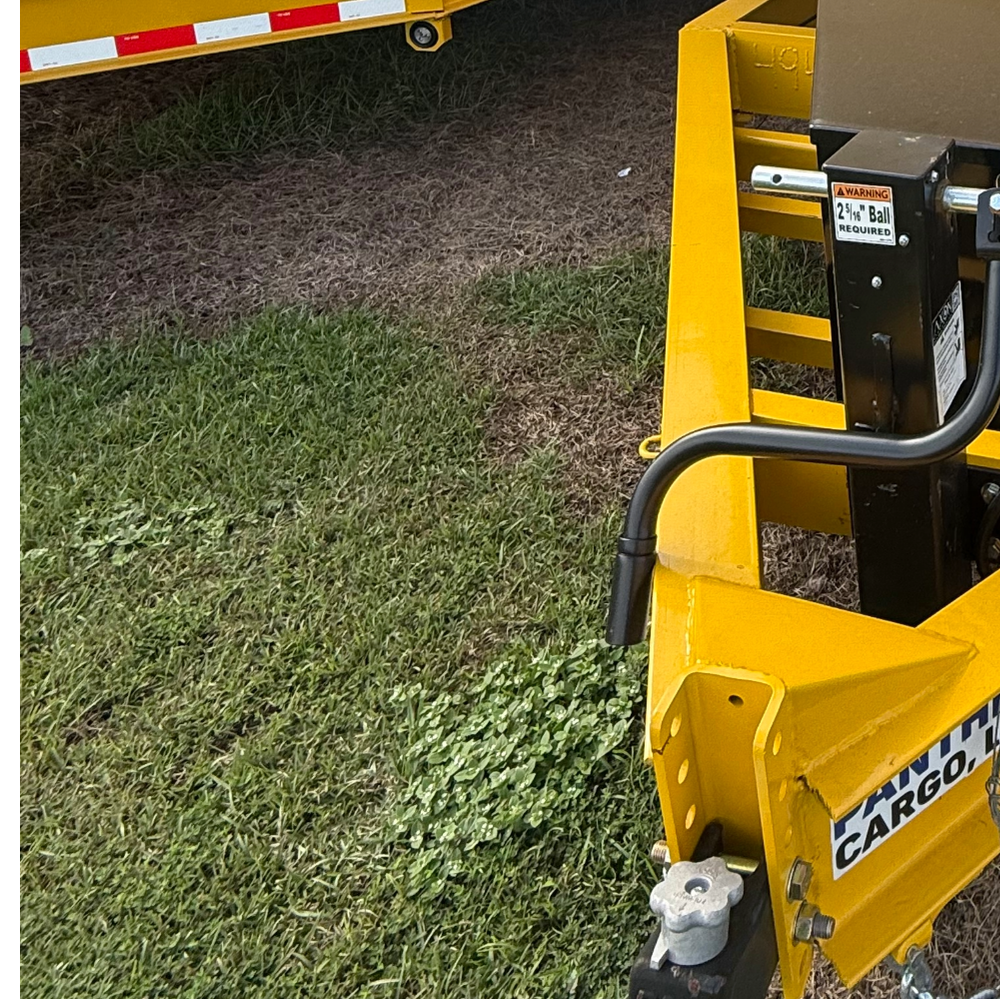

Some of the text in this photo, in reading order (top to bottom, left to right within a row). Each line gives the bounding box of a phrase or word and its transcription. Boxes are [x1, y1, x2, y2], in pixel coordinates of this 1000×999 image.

[845, 187, 889, 199] WARNING
[869, 205, 890, 224] Ball
[839, 224, 891, 237] REQUIRED
[835, 750, 977, 870] CARGO,
